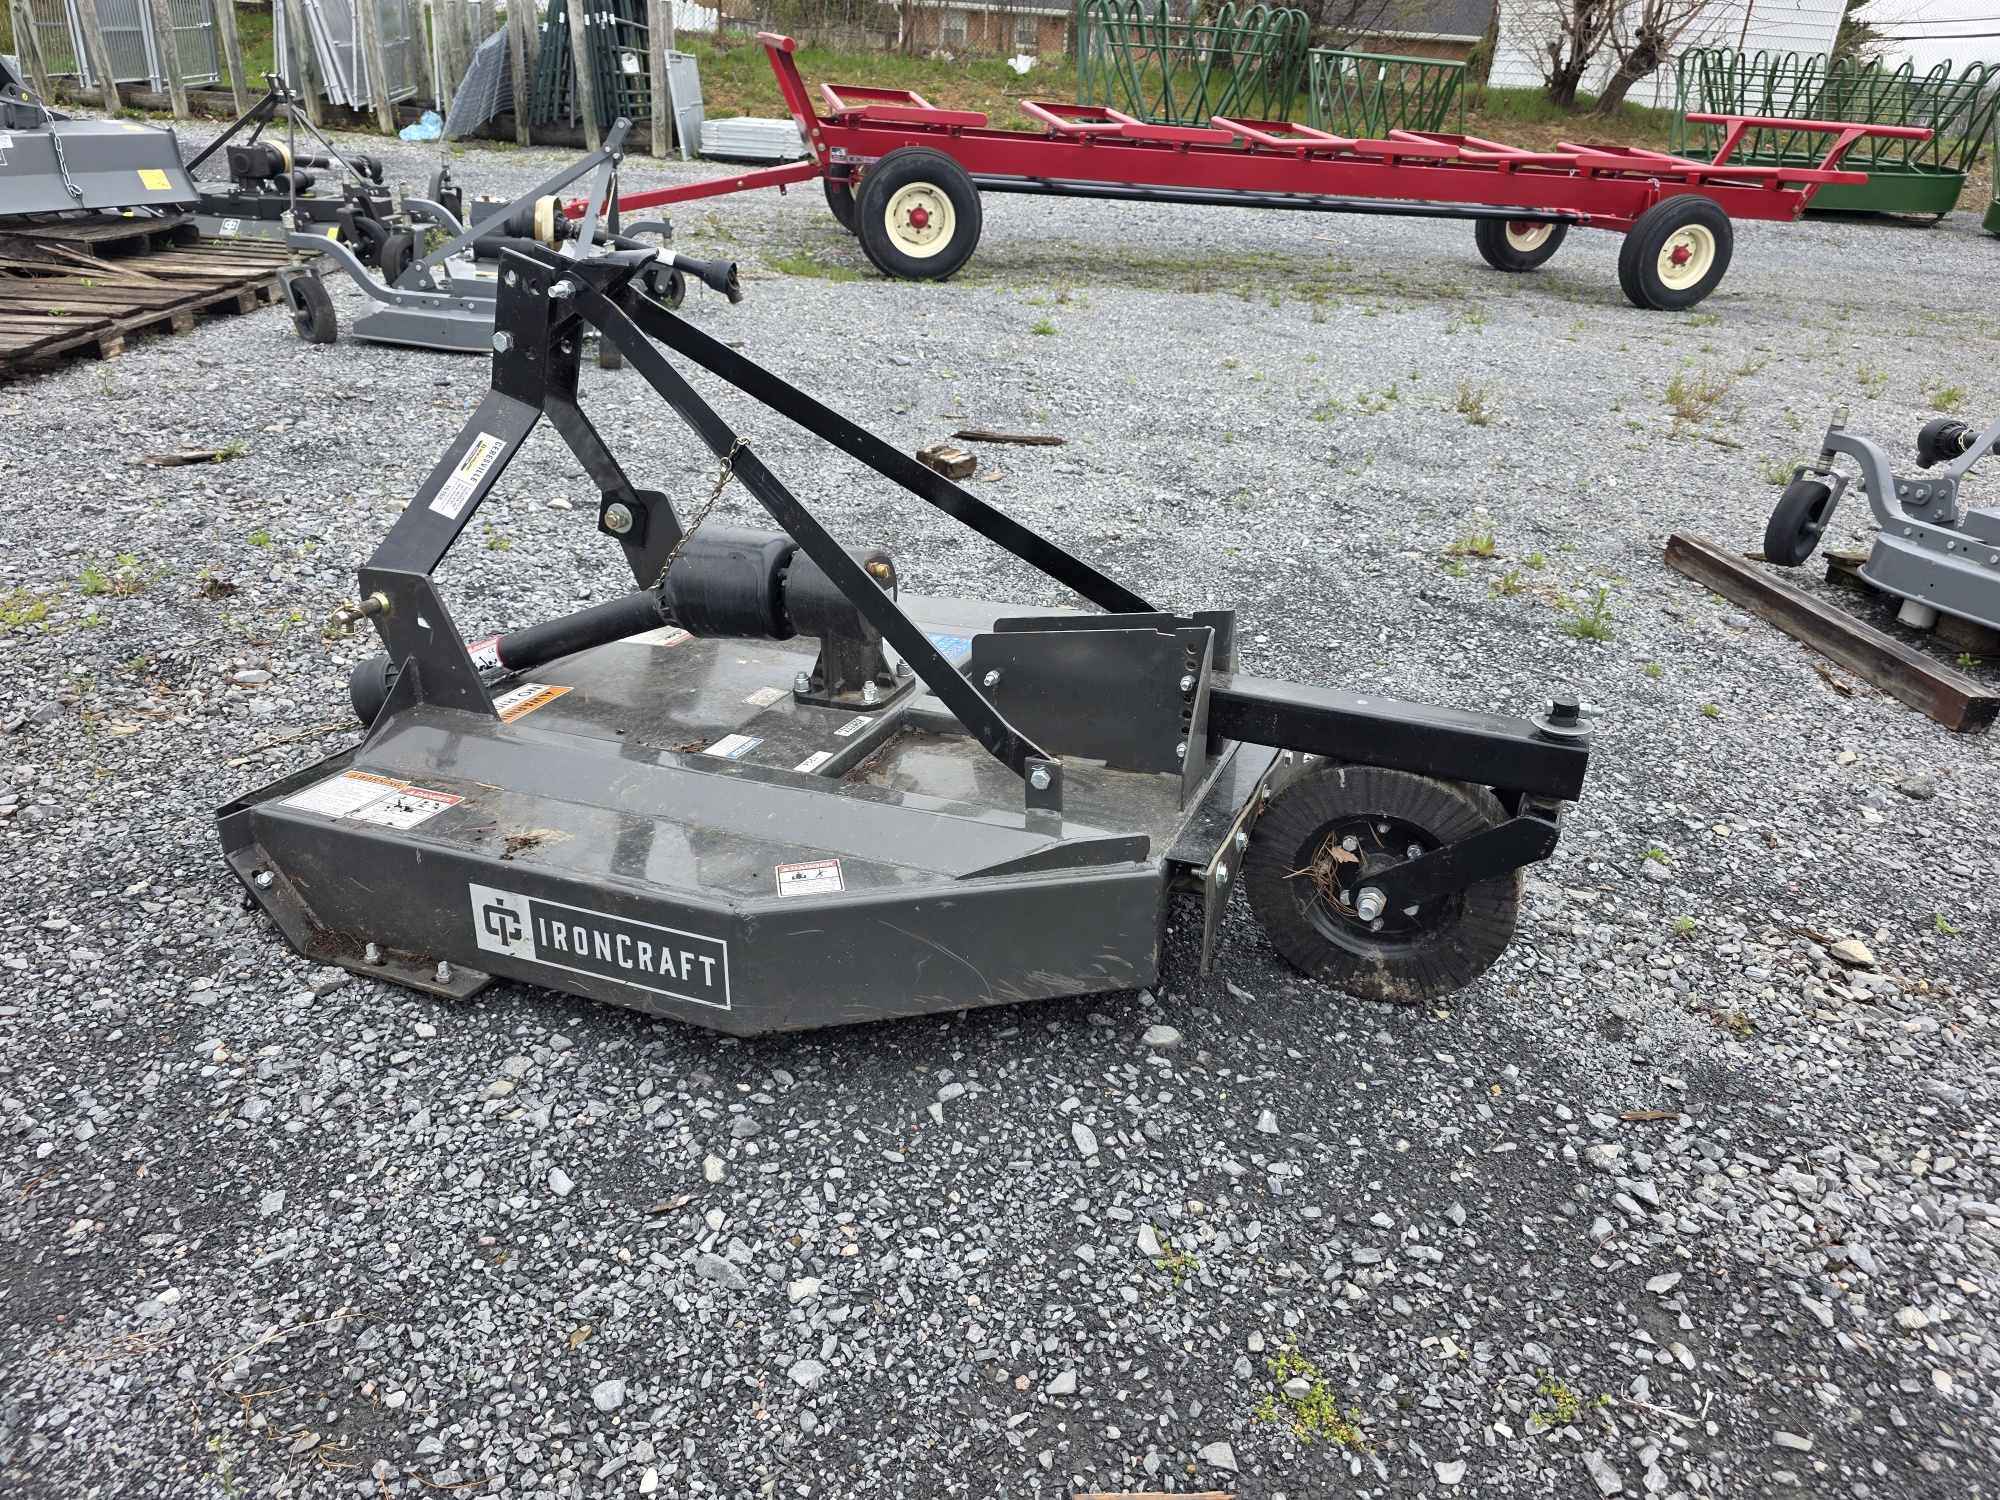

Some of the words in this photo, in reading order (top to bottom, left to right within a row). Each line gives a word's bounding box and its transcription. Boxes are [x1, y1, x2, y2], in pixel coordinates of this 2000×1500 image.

[469, 441, 502, 483] CERESVILLE
[356, 773, 403, 787] WARNING
[416, 791, 453, 803] DANGER
[790, 862, 832, 872] DANGER
[538, 917, 716, 986] IRONCRAFT
